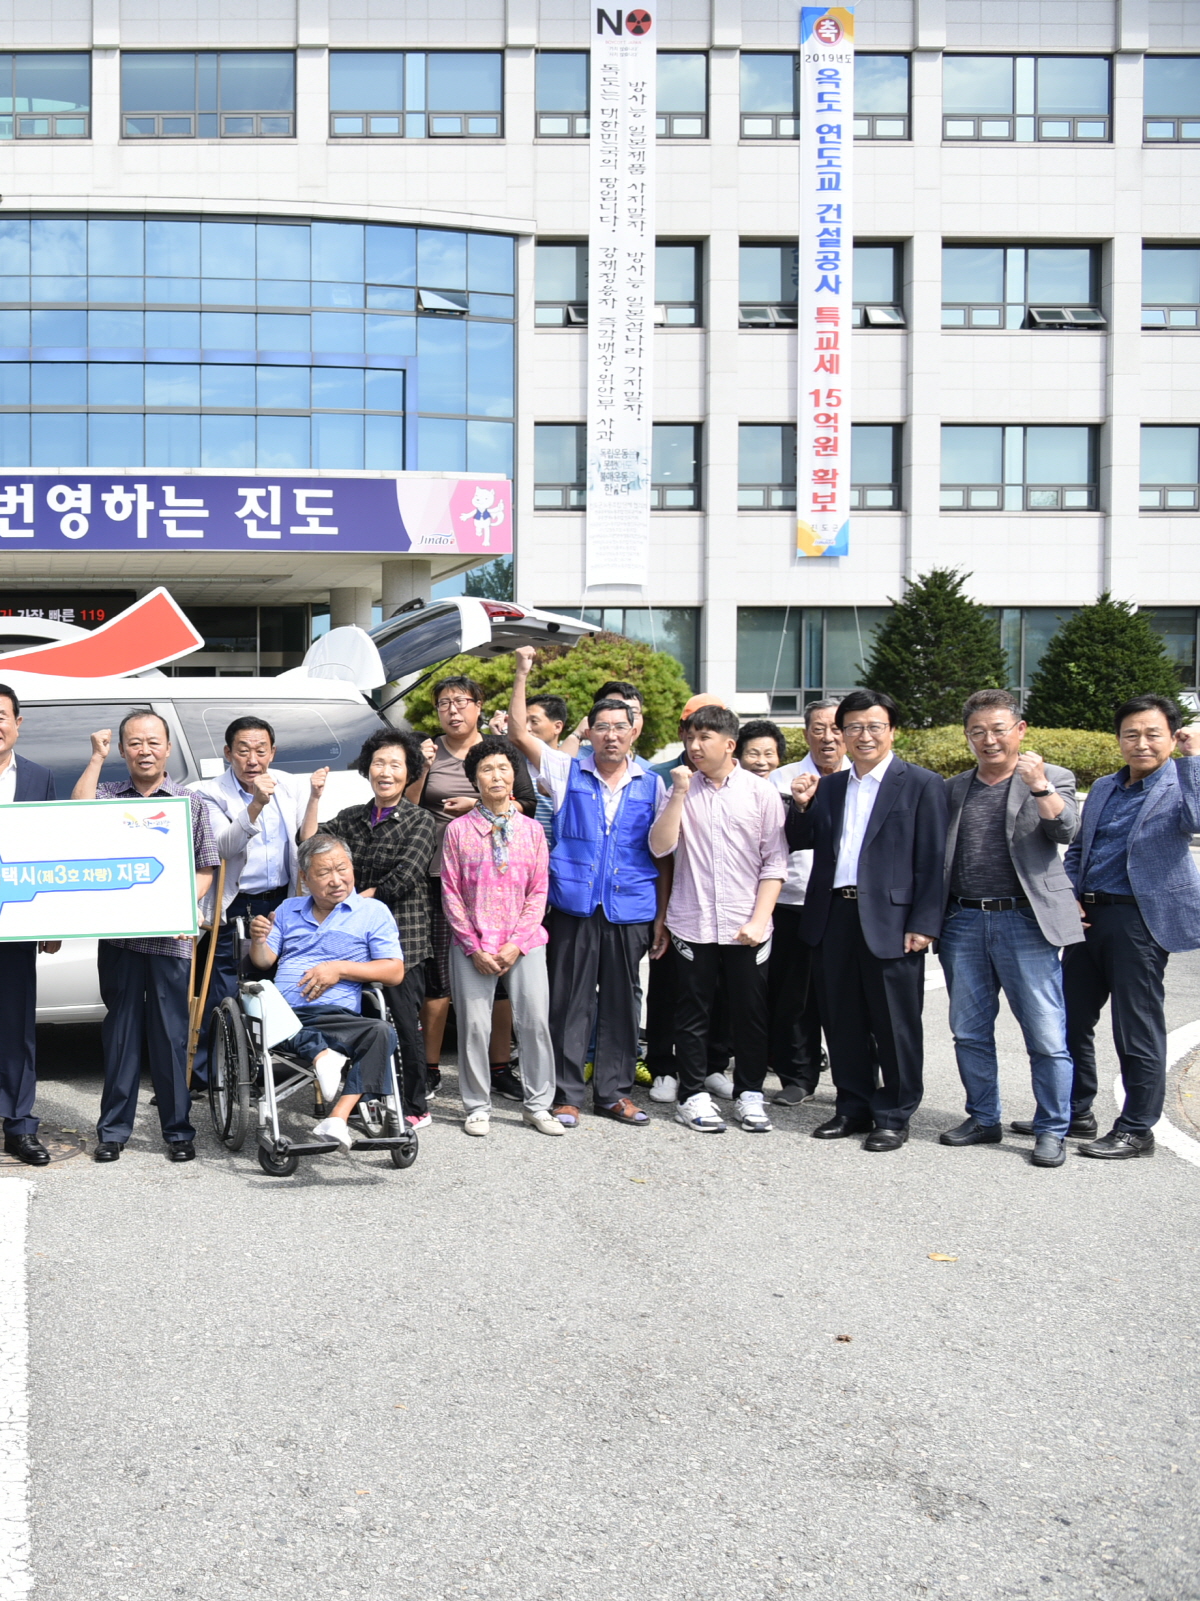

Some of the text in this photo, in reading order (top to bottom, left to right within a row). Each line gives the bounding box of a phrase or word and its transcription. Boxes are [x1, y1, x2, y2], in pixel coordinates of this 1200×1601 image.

[818, 19, 838, 42] 축
[600, 64, 620, 101] 독도는
[805, 53, 852, 63] 2019년도
[815, 67, 842, 113] 옥도
[599, 108, 620, 170] 대한민국의
[815, 123, 842, 192] 연도교
[599, 177, 620, 233] 땅입니다.
[623, 81, 647, 421] 방사능 일본제품 사지말자. 방사능 일본섬나라 가지말자.
[814, 203, 842, 295] 건설공사
[598, 247, 619, 307] 강제징용자
[813, 306, 841, 375] 특교세
[596, 418, 615, 442] 사과
[808, 388, 842, 457] 15억원
[234, 487, 339, 539] 진도
[810, 468, 839, 513] 확보
[48, 609, 76, 623] 빠른
[80, 609, 106, 621] 119
[82, 867, 113, 882] 차량)
[117, 862, 152, 882] 지원
